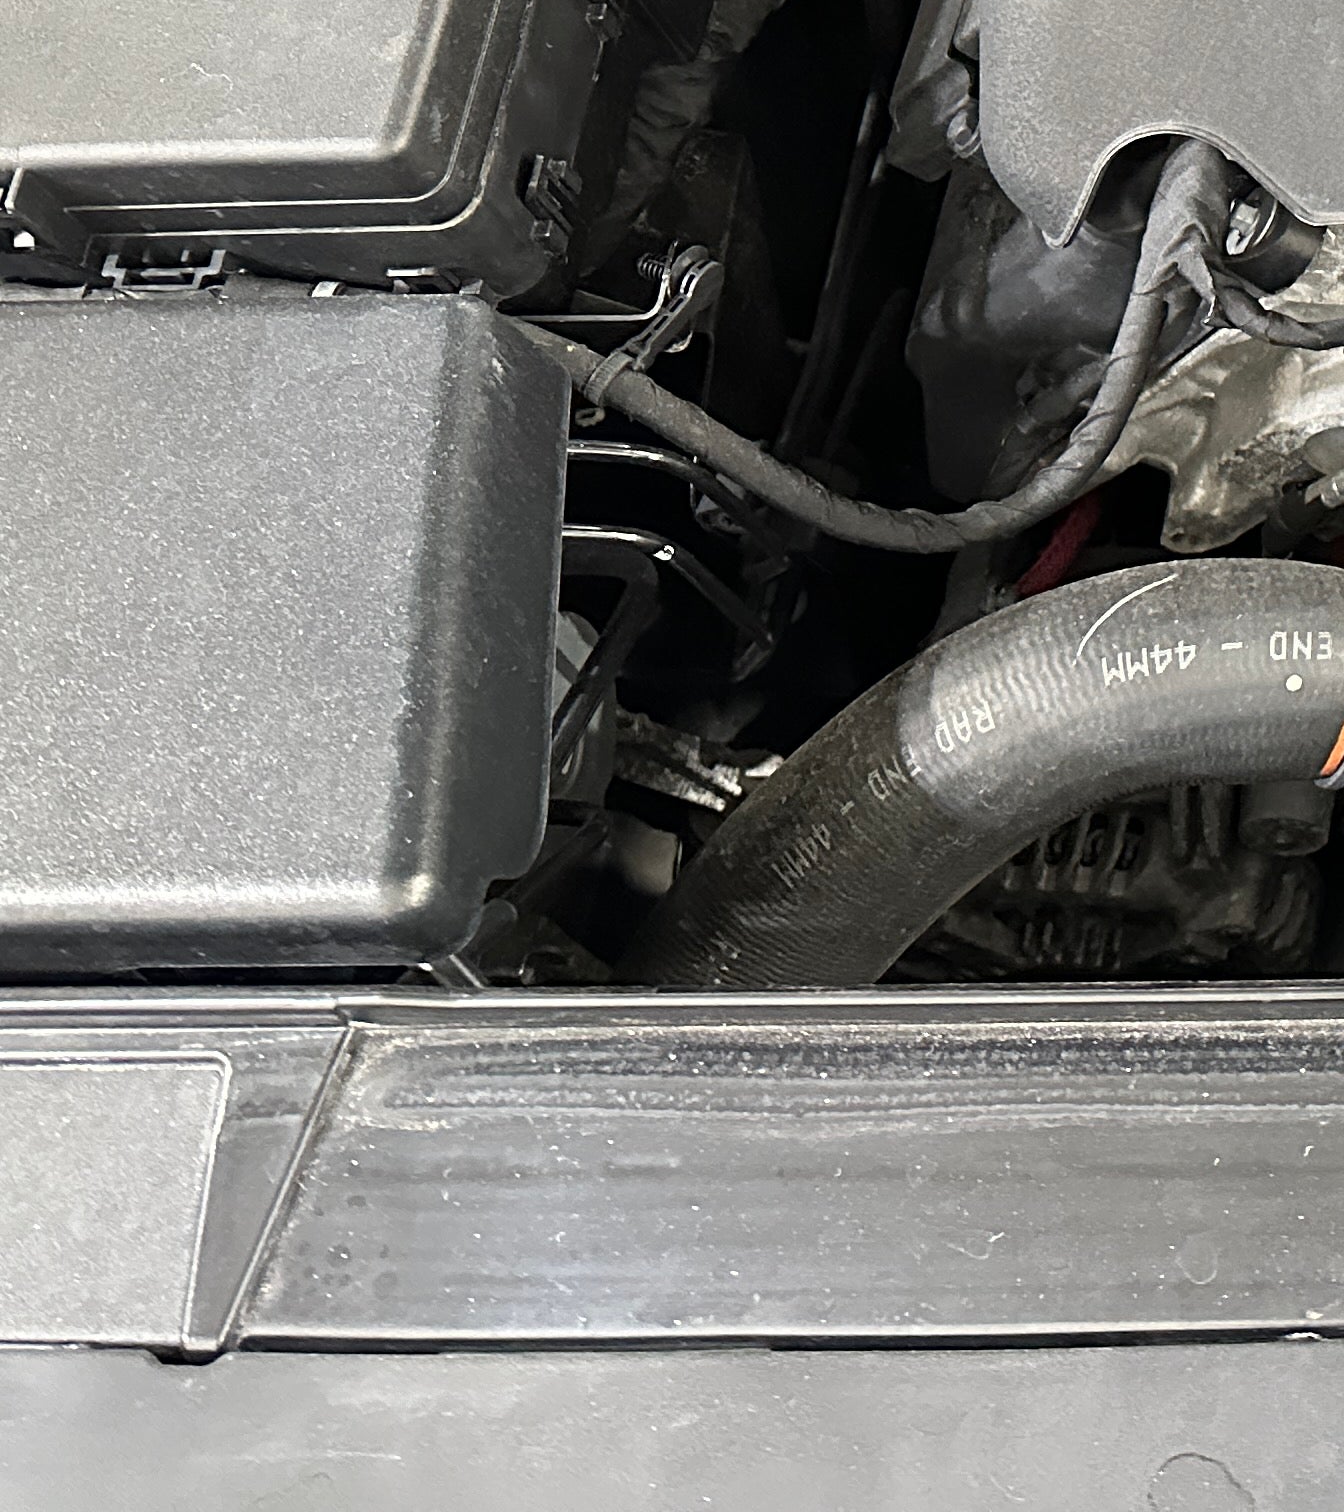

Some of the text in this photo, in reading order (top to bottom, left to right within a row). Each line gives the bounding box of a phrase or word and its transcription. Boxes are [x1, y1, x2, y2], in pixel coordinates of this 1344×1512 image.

[1101, 639, 1197, 689] 44MM
[1269, 630, 1333, 661] END
[934, 698, 996, 753] RAD
